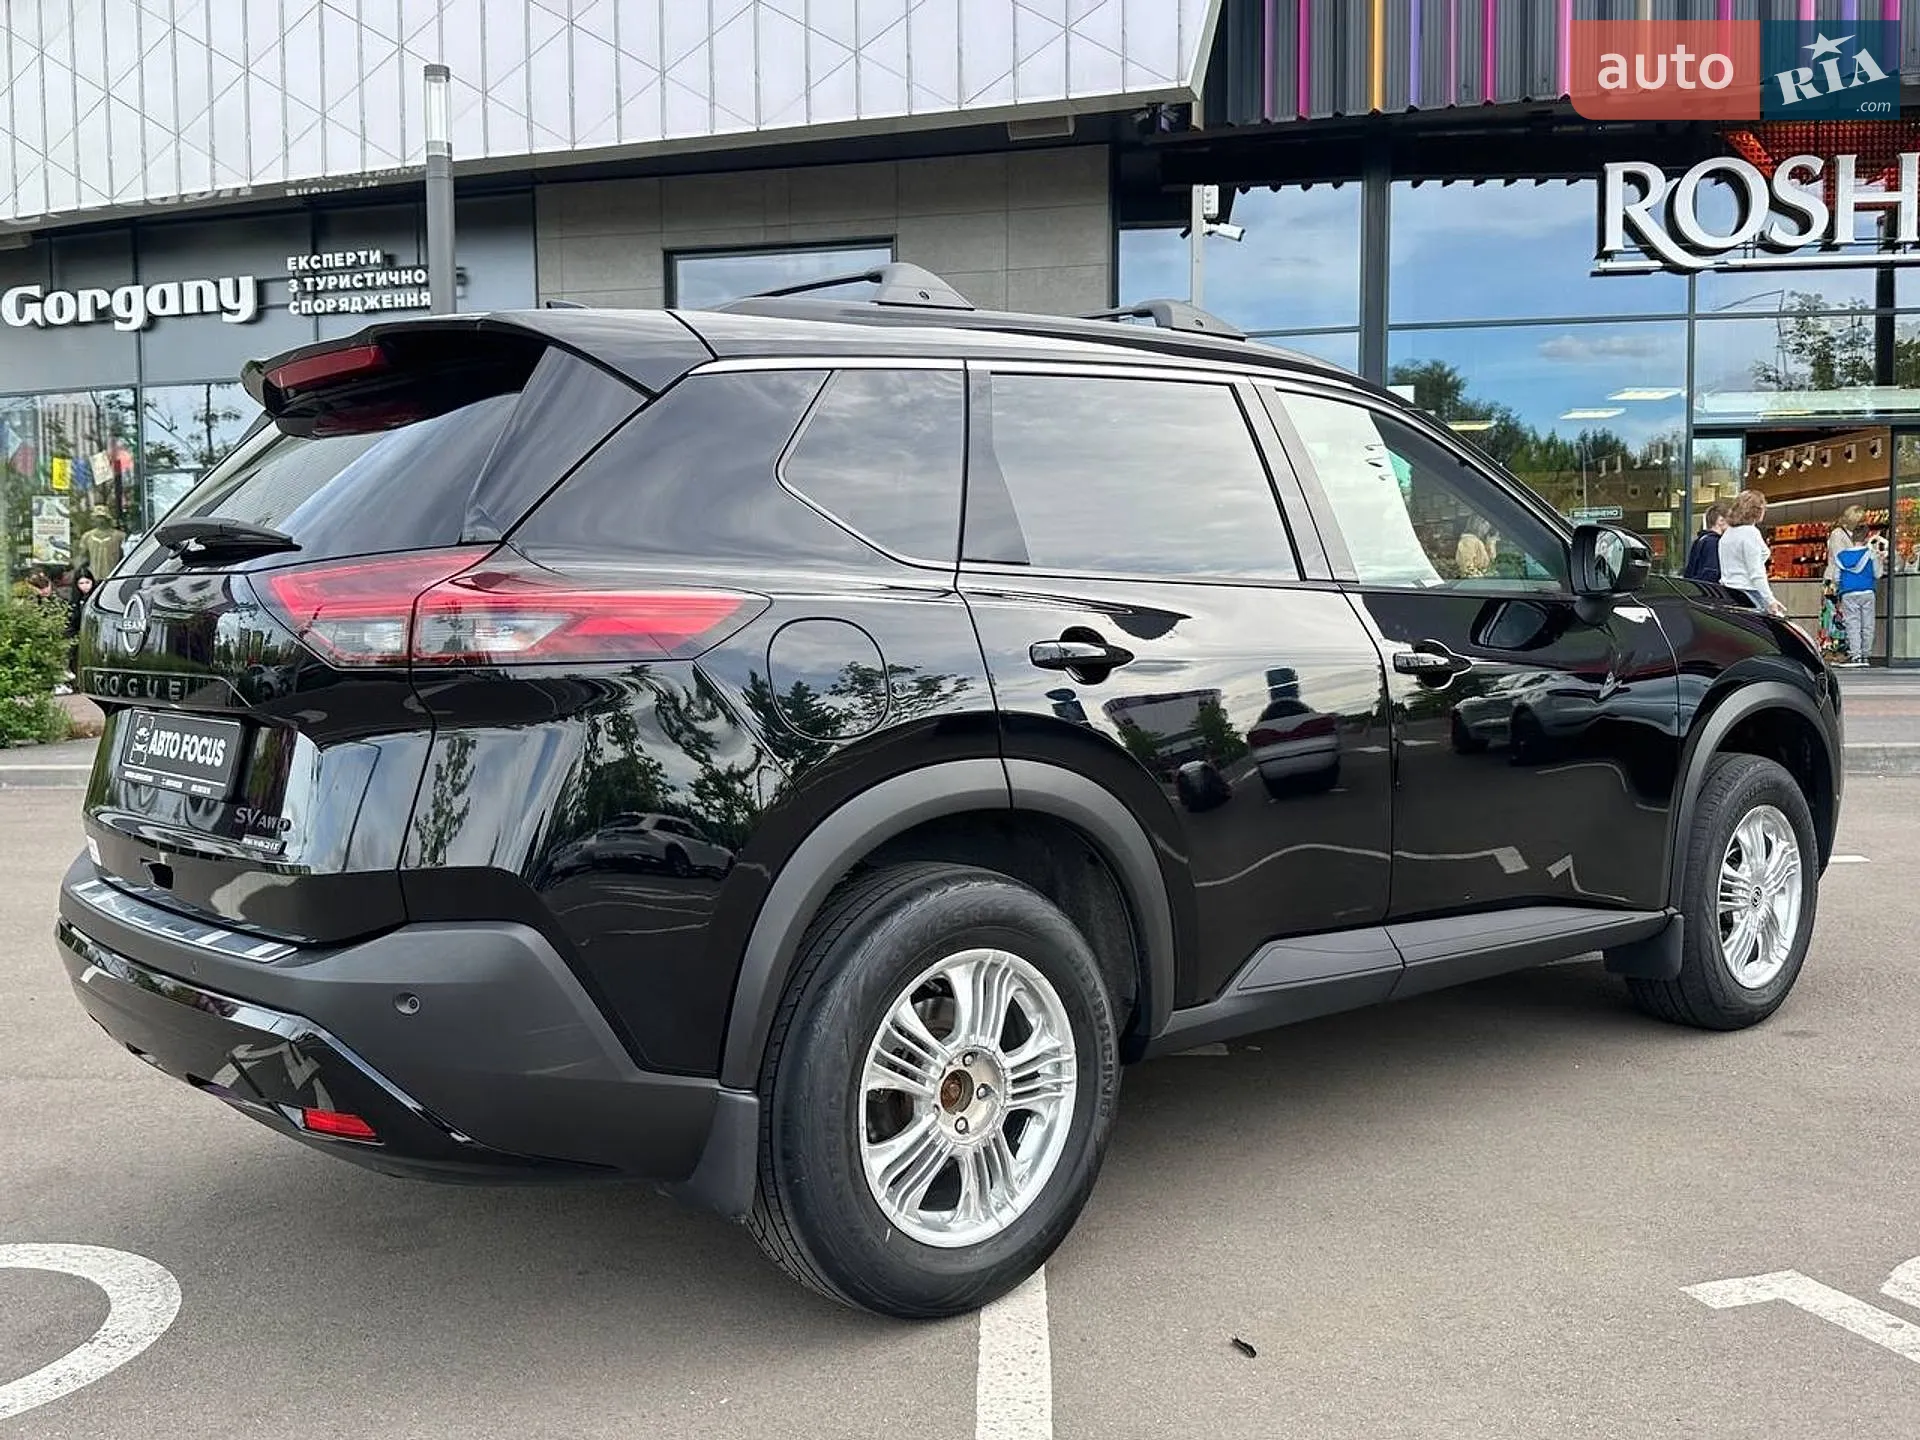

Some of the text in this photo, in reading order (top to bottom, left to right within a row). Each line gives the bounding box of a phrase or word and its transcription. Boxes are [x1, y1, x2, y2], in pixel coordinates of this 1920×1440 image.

[1603, 152, 1920, 268] ROSH
[287, 250, 381, 271] ЕКСПЕРТИ
[1, 276, 254, 331] Gorgany
[288, 292, 431, 314] СПОРЯДЖЕННЯ
[94, 672, 181, 700] ROGUE
[180, 734, 226, 767] FOCUS
[234, 807, 261, 825] SV
